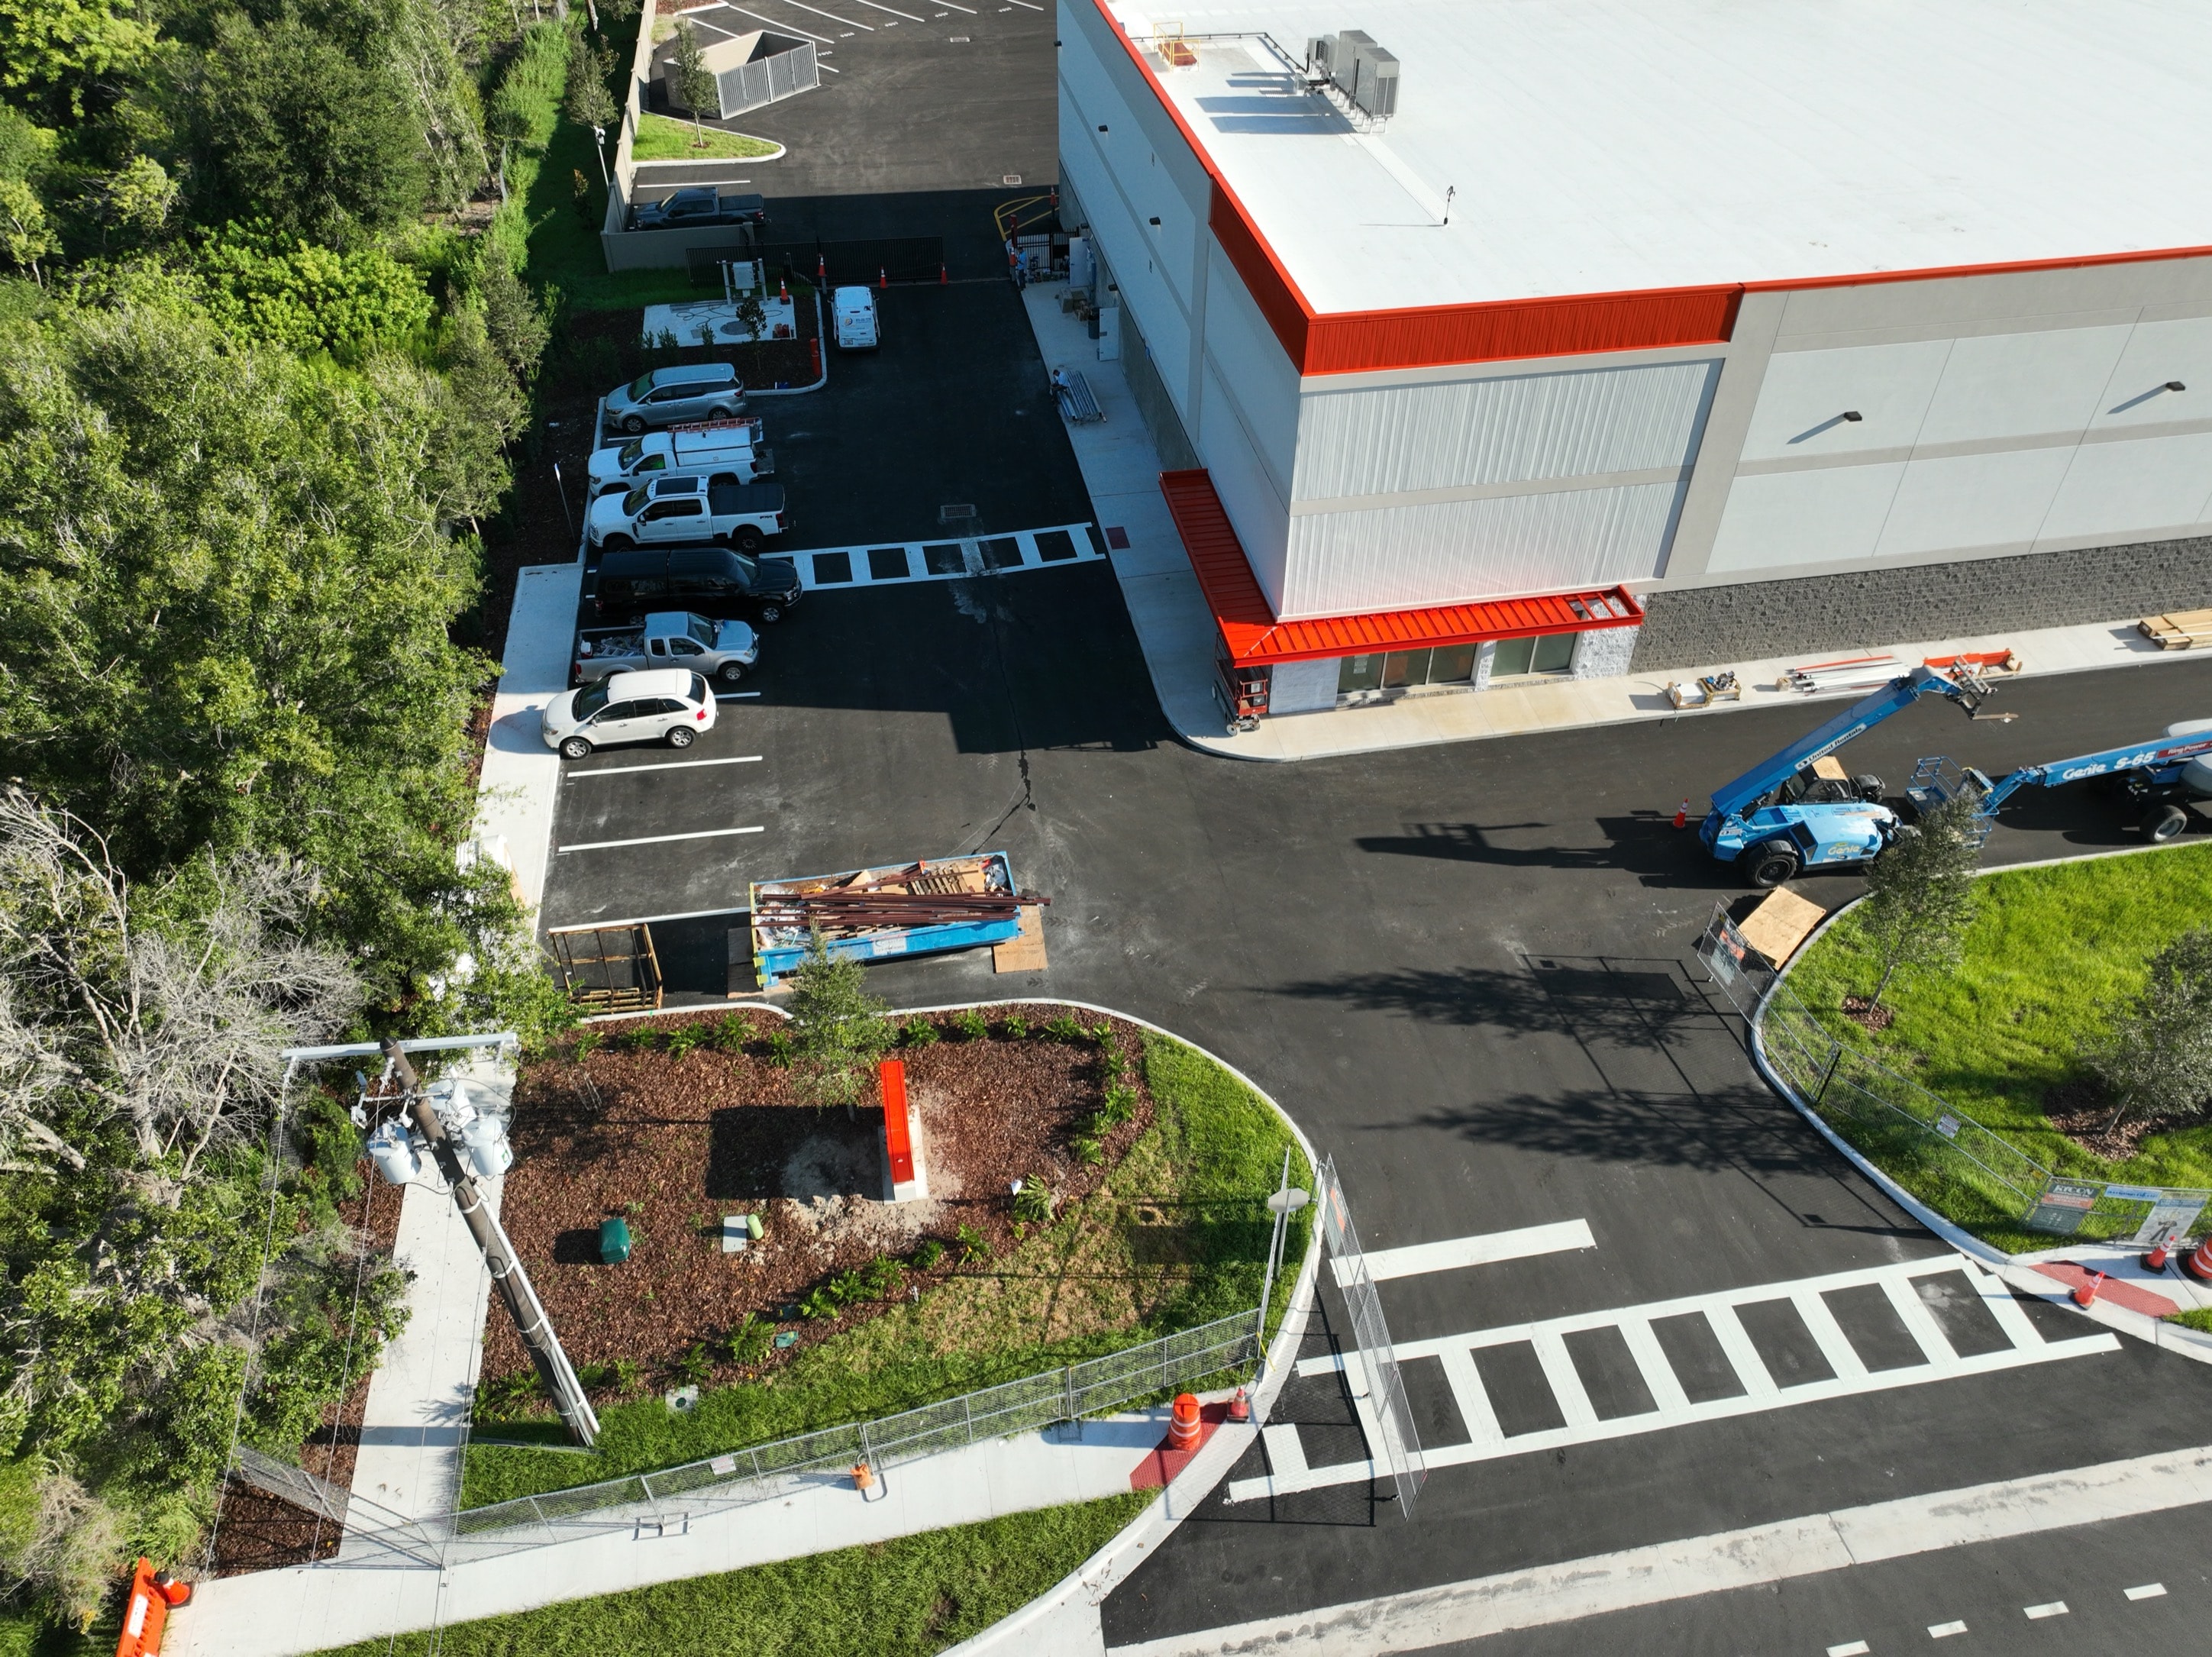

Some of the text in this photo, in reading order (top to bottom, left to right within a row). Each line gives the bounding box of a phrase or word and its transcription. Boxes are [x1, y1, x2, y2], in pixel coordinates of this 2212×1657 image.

[1808, 727, 1862, 761] United Rentals
[2062, 751, 2156, 780] Genie S-65
[1828, 845, 1860, 855] Genie
